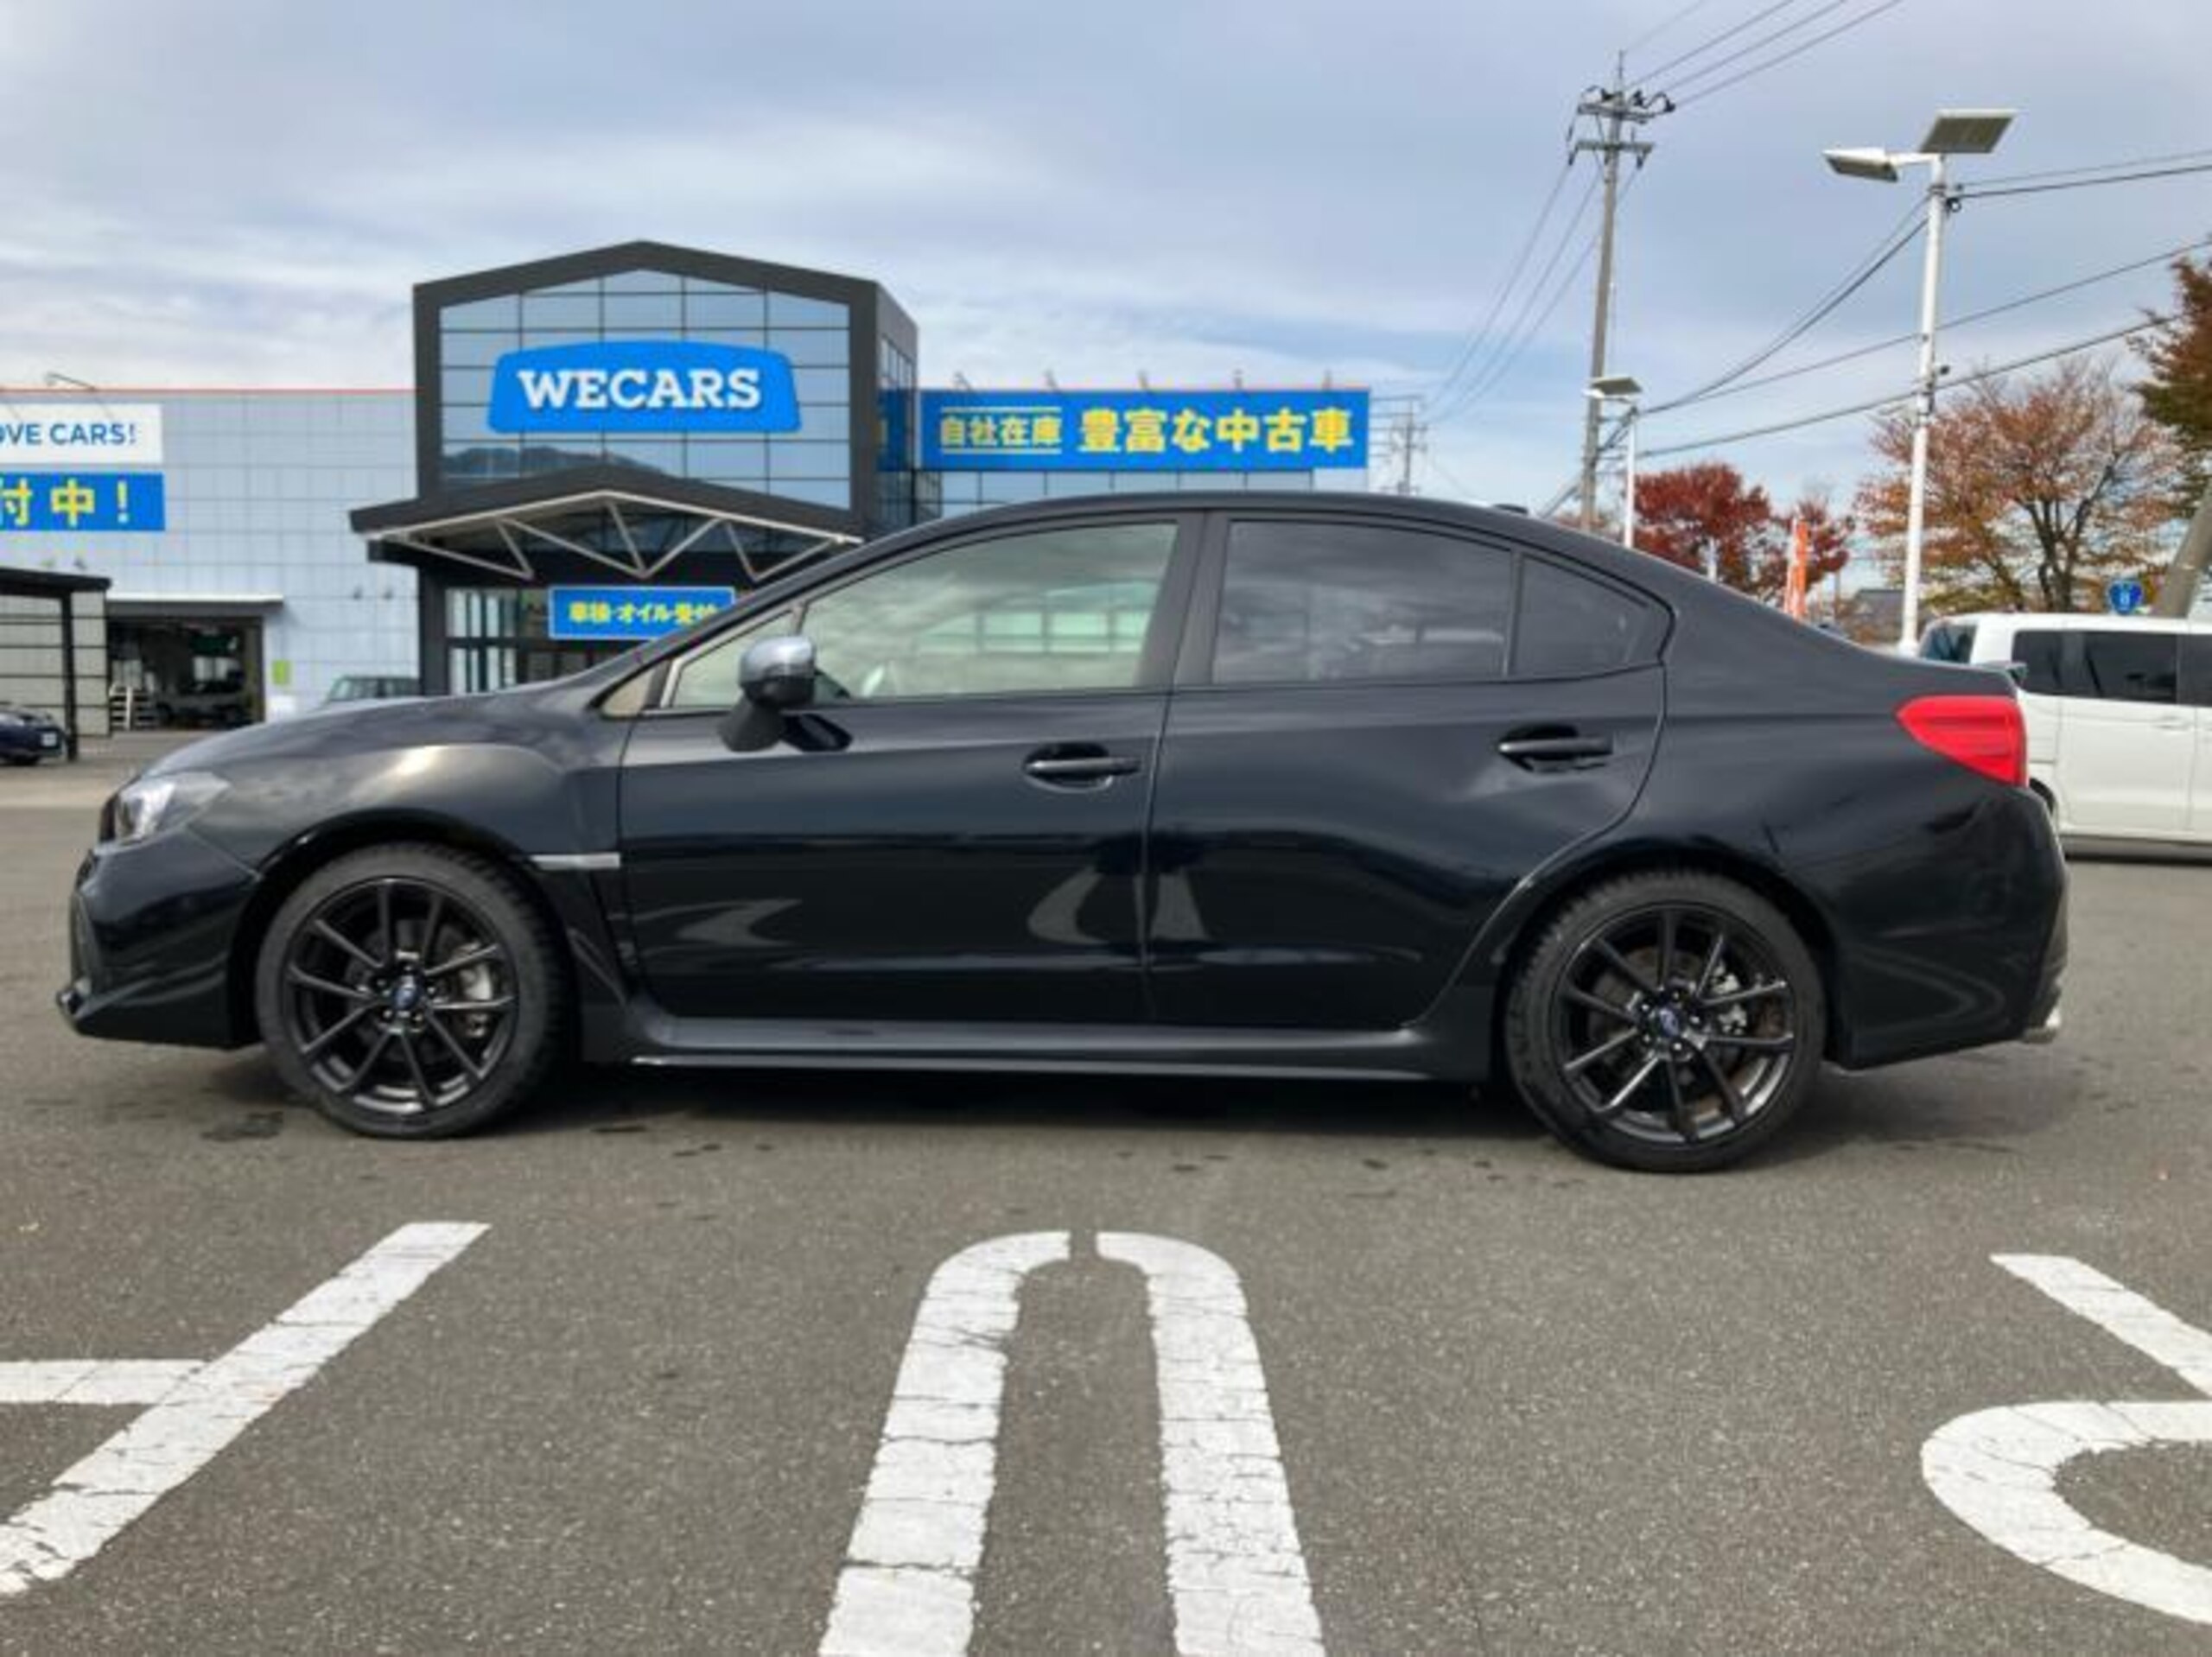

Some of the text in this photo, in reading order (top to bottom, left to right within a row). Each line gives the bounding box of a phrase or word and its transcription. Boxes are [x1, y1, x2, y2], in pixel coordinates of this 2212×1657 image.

[517, 369, 760, 409] WECARS
[0, 422, 137, 446] VE CARS!
[1077, 408, 1354, 453] 豊富な中古車
